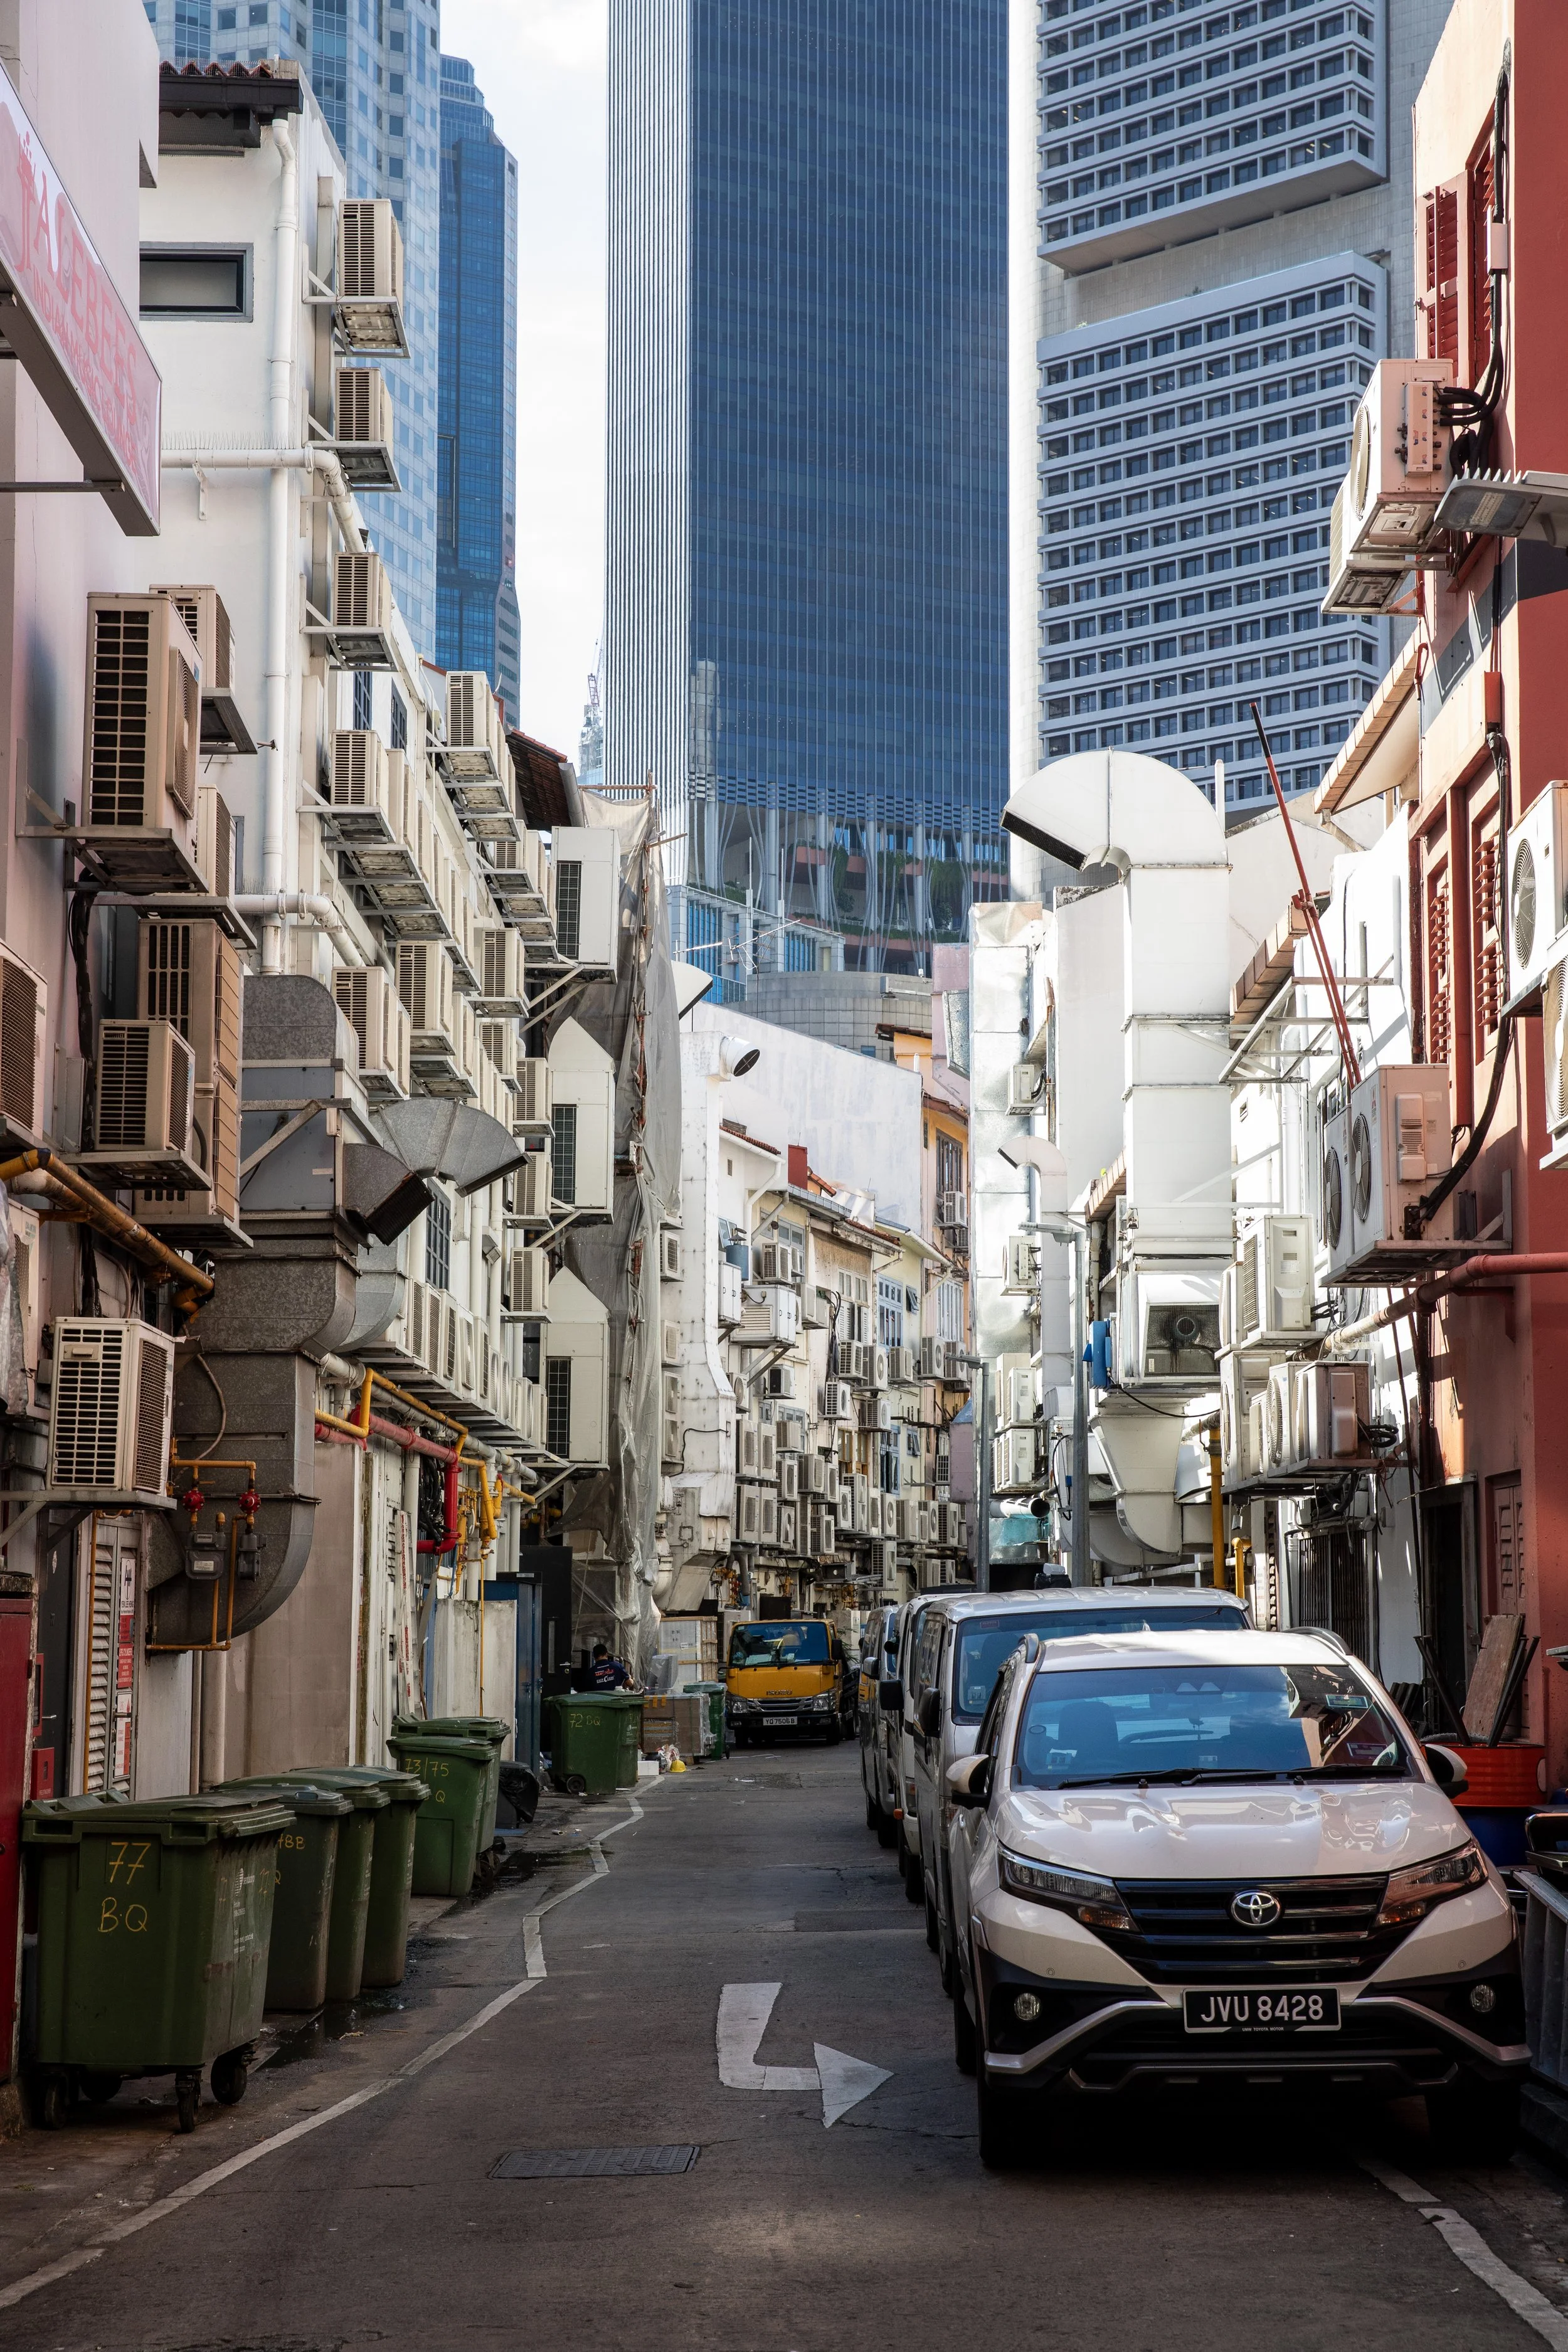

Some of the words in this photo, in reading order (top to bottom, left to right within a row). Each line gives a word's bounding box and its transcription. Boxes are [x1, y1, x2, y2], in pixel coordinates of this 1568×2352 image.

[14, 131, 137, 426] JALEBEES
[569, 1714, 583, 1728] 72
[109, 1841, 151, 1885] 77
[1200, 1996, 1249, 2023] JVU
[1257, 1994, 1323, 2021] 8428
